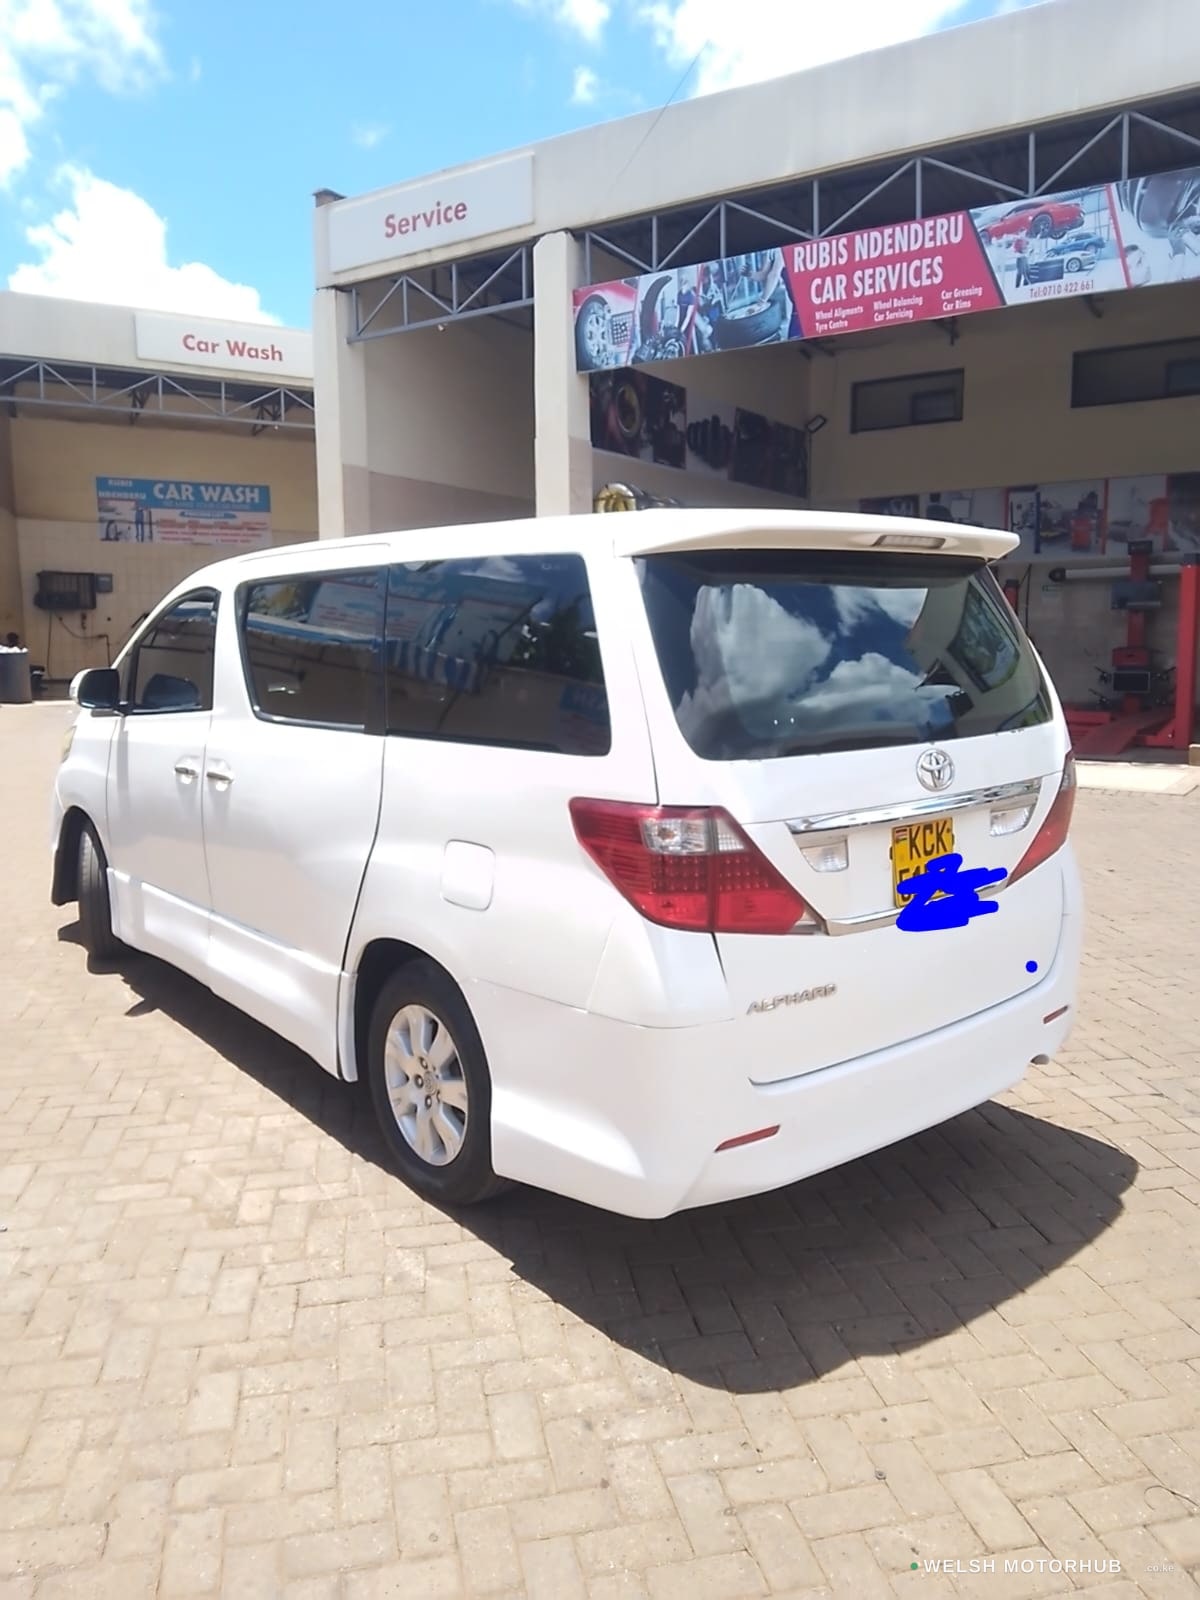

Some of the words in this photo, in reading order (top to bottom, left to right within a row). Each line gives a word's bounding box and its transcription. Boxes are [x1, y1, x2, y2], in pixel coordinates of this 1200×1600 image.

[385, 201, 467, 238] Service
[793, 238, 848, 272] RUBIS
[854, 214, 963, 262] NDENDERU
[810, 274, 847, 305] CAR
[853, 256, 943, 298] SERVICES
[1064, 281, 1078, 293] 422
[1080, 279, 1094, 290] 661
[873, 299, 892, 311] Wheel
[893, 294, 923, 308] Balancing
[941, 289, 952, 300] Car
[815, 309, 833, 321] Wheel
[874, 312, 885, 322] Car
[885, 308, 913, 321] Servicing
[942, 301, 953, 311] Car
[815, 321, 828, 333] Tyre
[182, 334, 220, 353] Car
[226, 339, 283, 362] Wash
[153, 482, 195, 501] CAR
[201, 485, 260, 503] WASH
[908, 820, 948, 860] KCK
[746, 983, 836, 1015] ALPHARD
